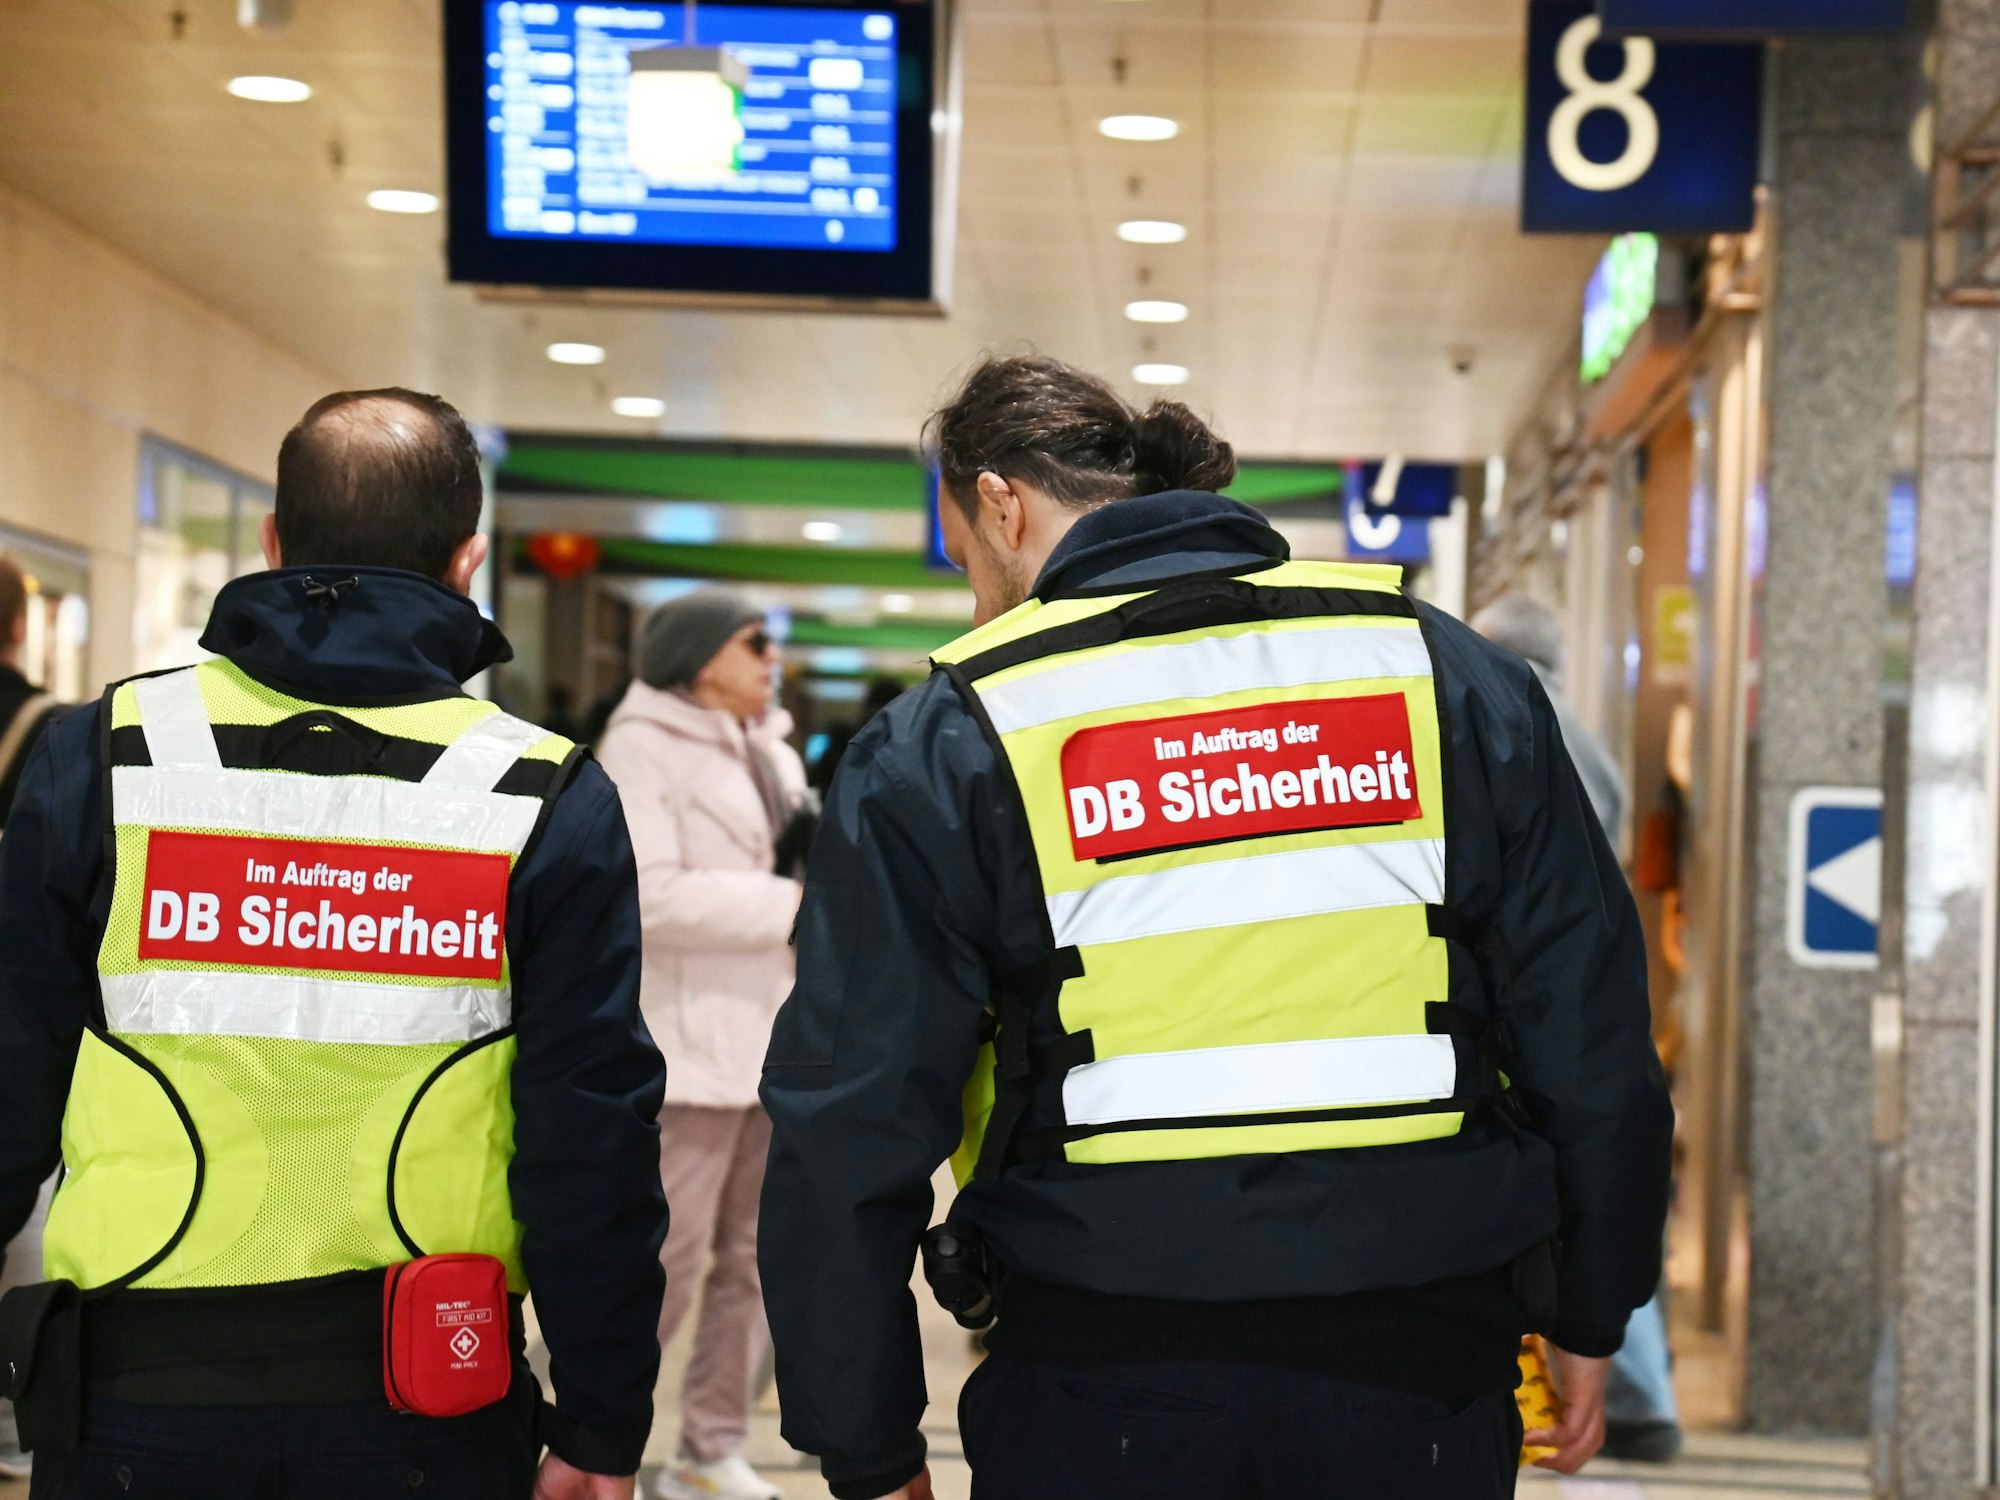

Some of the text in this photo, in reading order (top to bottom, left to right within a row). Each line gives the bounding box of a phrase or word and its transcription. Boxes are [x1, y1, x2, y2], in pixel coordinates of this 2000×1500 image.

[1547, 14, 1660, 192] 8
[1153, 720, 1320, 761] Im Auftrag der
[1068, 750, 1412, 839] DB Sicherheit
[245, 858, 413, 896] Im Auftrag der
[147, 889, 499, 960] DB Sicherheit
[442, 1311, 487, 1323] FIRST AID KIT
